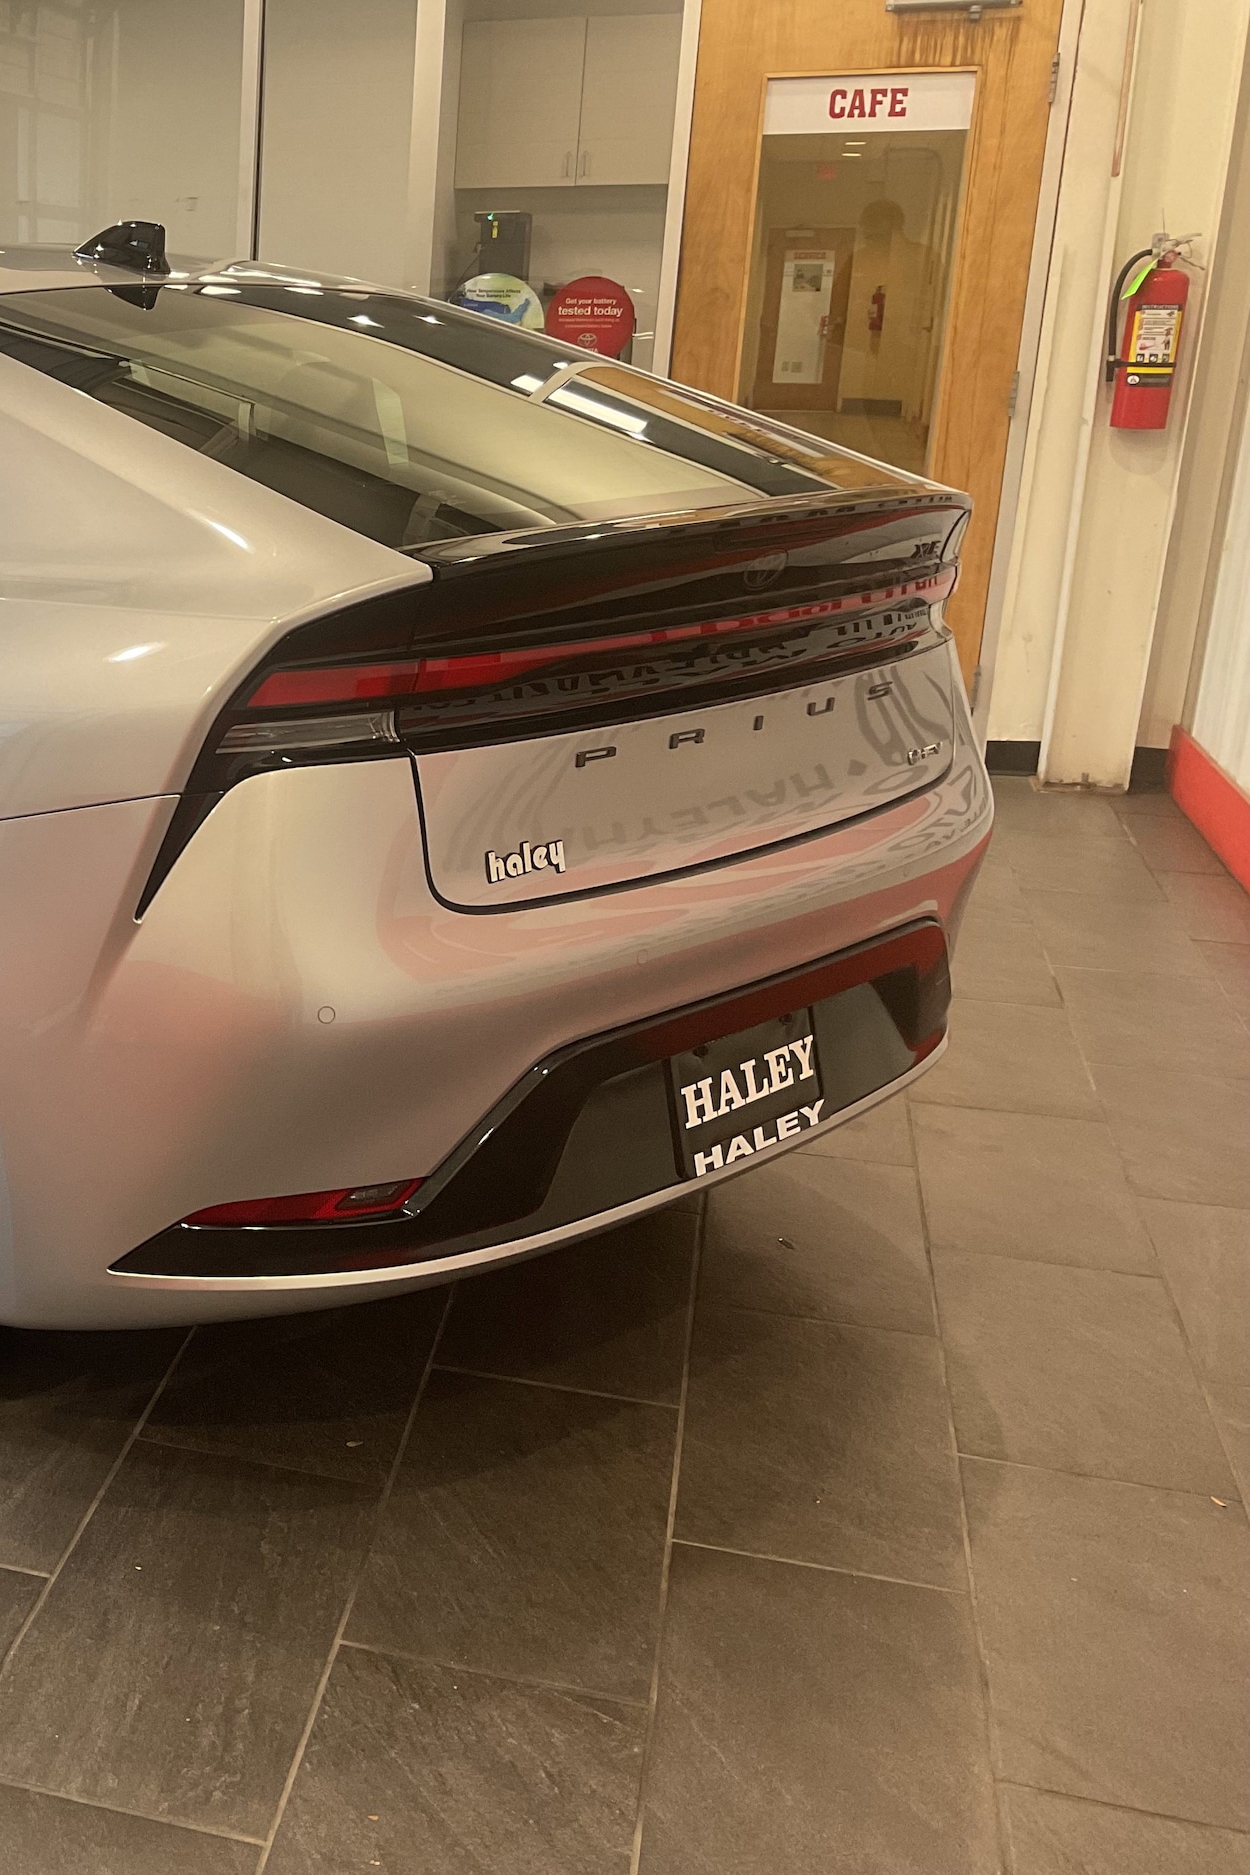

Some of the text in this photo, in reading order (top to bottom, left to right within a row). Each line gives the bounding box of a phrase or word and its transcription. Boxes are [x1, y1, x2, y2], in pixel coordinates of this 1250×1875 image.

[829, 88, 909, 119] CAFE
[558, 306, 623, 318] tested today
[574, 680, 893, 769] PRIUS
[485, 839, 566, 884] haley
[680, 1034, 814, 1130] HALEY
[694, 1098, 825, 1177] HALEY
